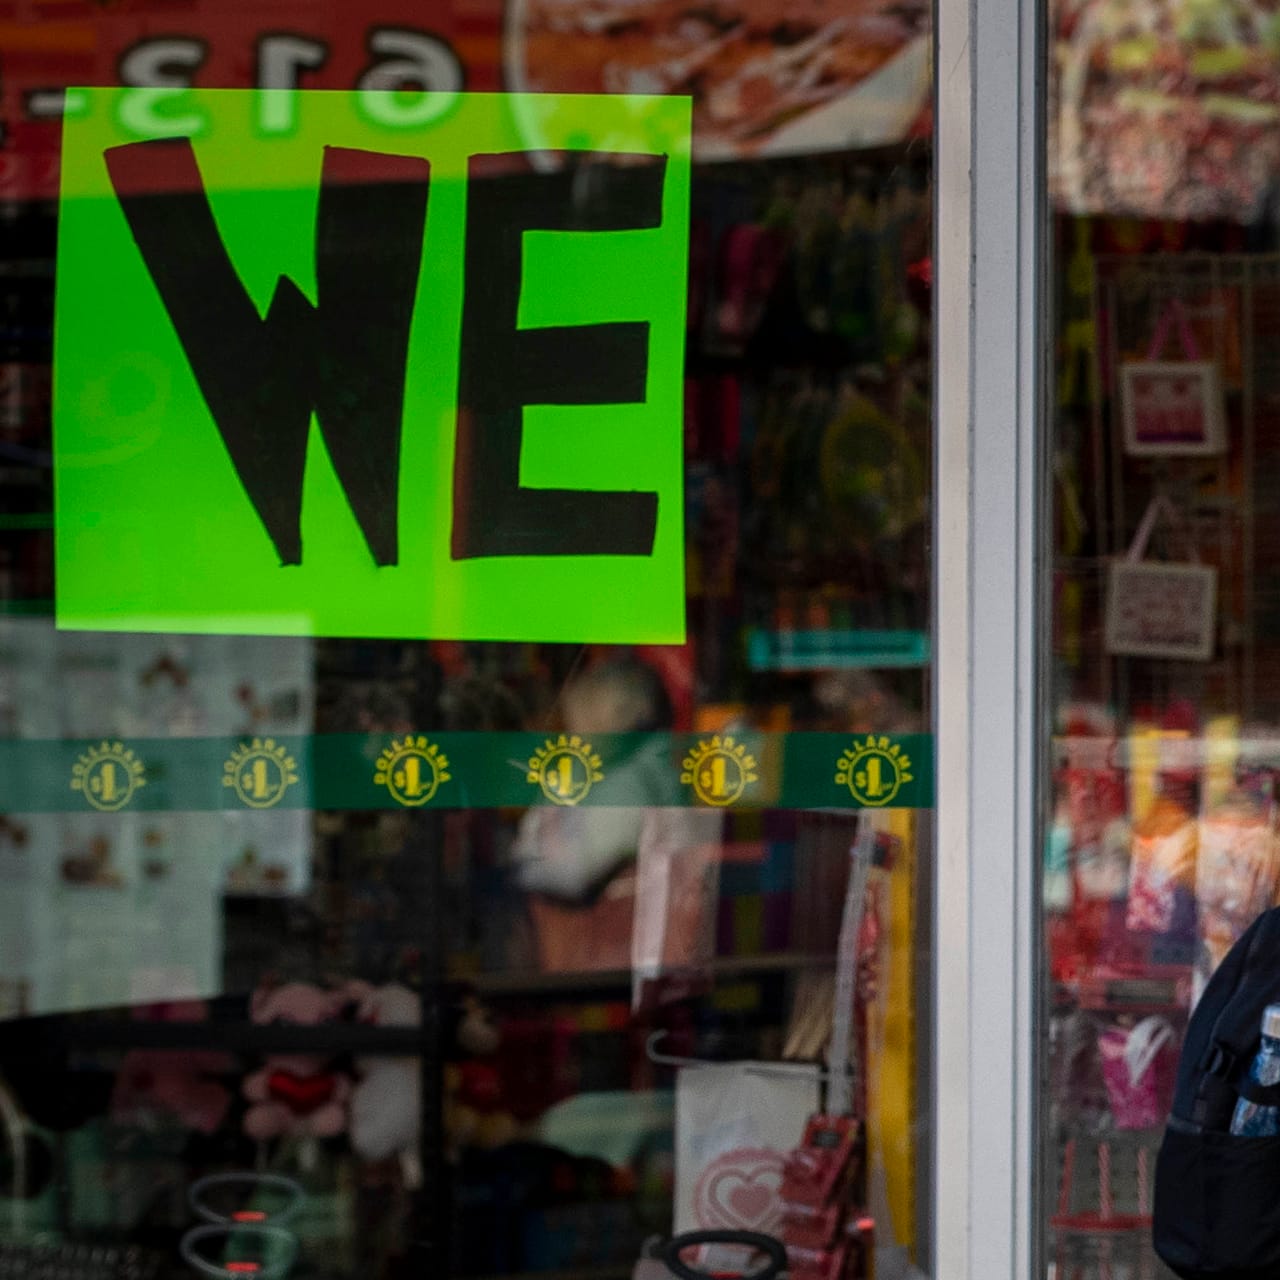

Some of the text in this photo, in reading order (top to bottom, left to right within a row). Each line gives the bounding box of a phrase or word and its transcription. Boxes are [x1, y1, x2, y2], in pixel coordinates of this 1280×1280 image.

[103, 136, 669, 567] WE
[70, 740, 147, 791] DOLLARAMA
[222, 737, 299, 788] DOLLARAMA
[373, 735, 452, 785] DOLLARAMA
[526, 734, 605, 785] DOLLARAMA
[680, 735, 760, 785] DOLLARAMA
[834, 735, 914, 785] DOLLARAMA
